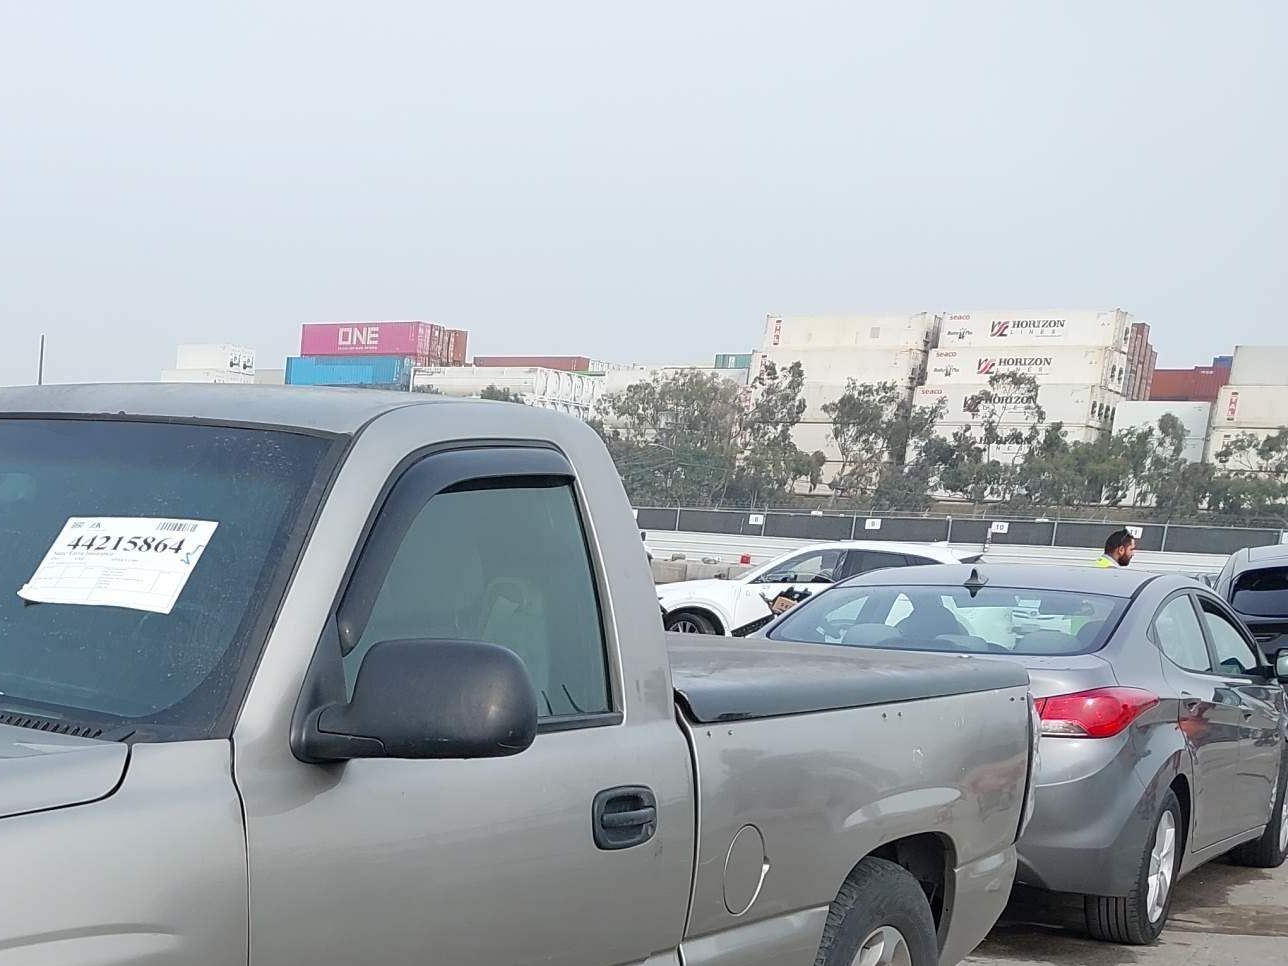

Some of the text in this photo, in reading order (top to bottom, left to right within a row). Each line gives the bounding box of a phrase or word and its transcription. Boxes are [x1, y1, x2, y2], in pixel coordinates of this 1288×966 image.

[1012, 319, 1065, 328] HORIZON
[339, 327, 379, 345] ONE
[998, 358, 1051, 366] HORIZON
[67, 535, 186, 554] 44215864
